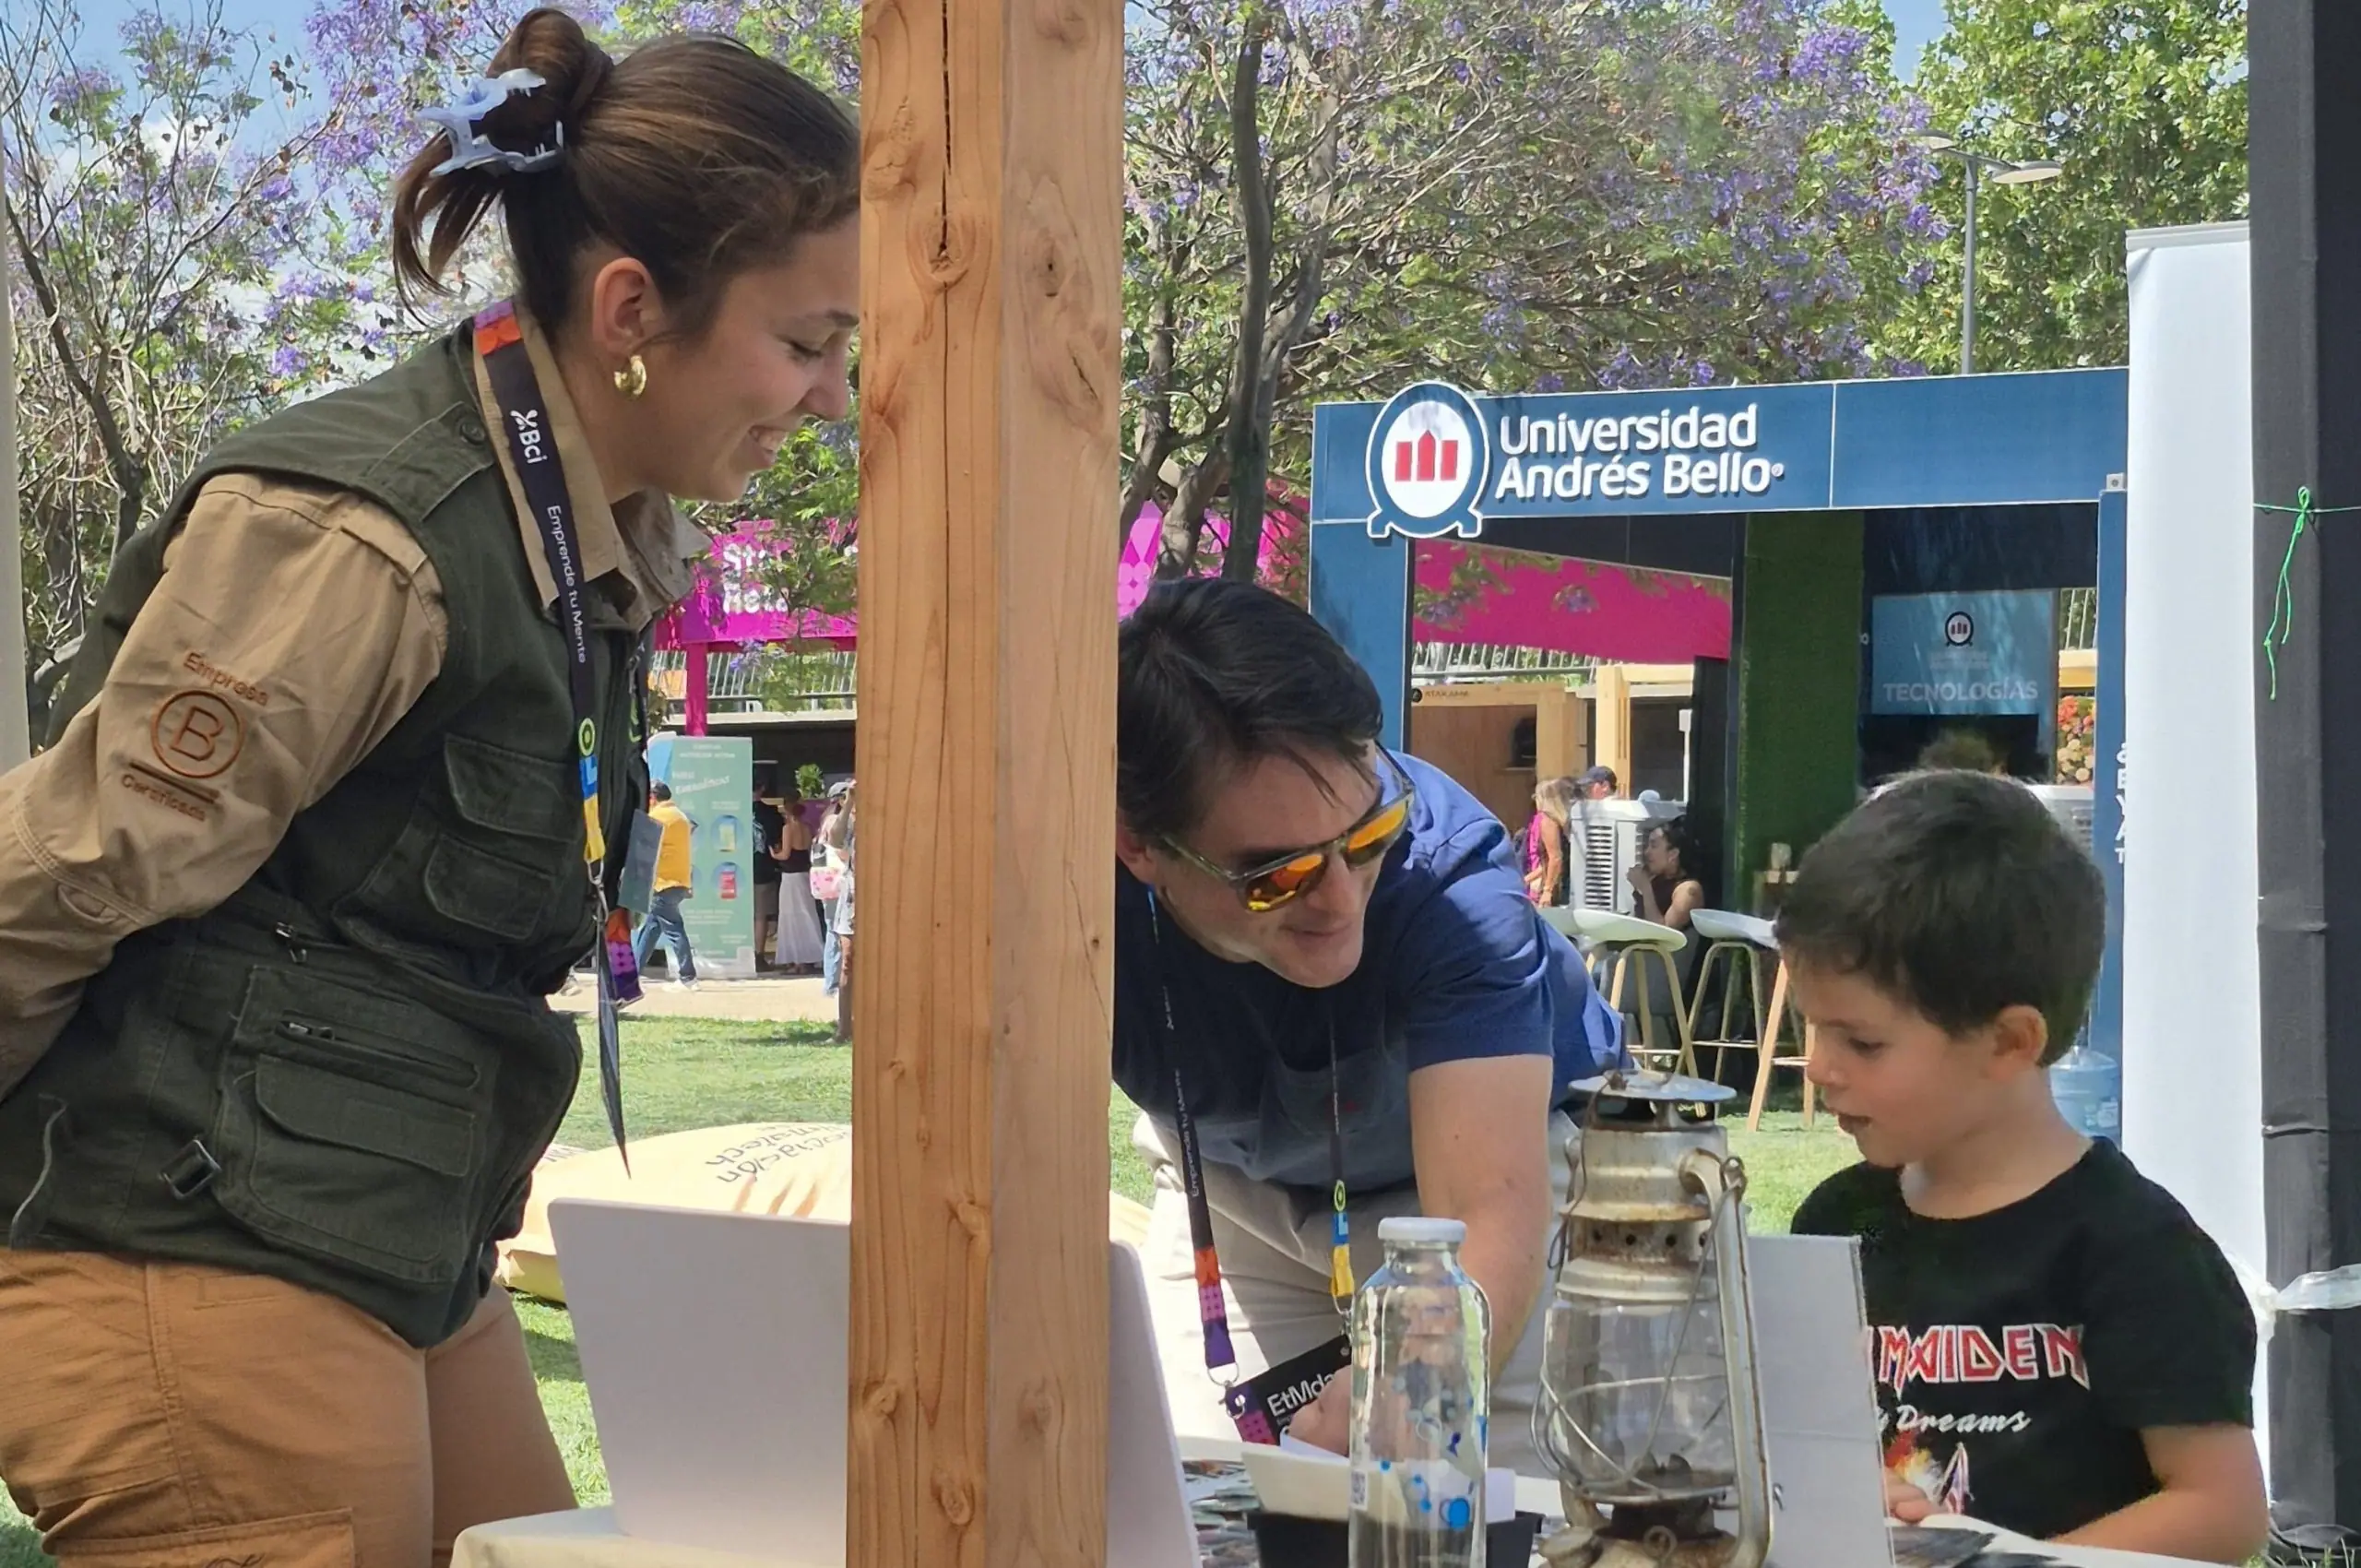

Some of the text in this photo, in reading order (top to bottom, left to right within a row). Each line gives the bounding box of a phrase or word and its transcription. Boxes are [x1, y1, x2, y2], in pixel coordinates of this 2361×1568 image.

[518, 429, 548, 464] Bci
[1501, 403, 1757, 455] Universidad
[1495, 455, 1651, 499] Andrés
[547, 505, 586, 664] Emprende tu Mente
[183, 651, 270, 707] Empresa
[1882, 676, 2039, 703] TECNOLOGÍAS
[170, 705, 225, 762] B
[1878, 1323, 2091, 1401] MAIDEN
[1895, 1404, 2033, 1433] Dreams
